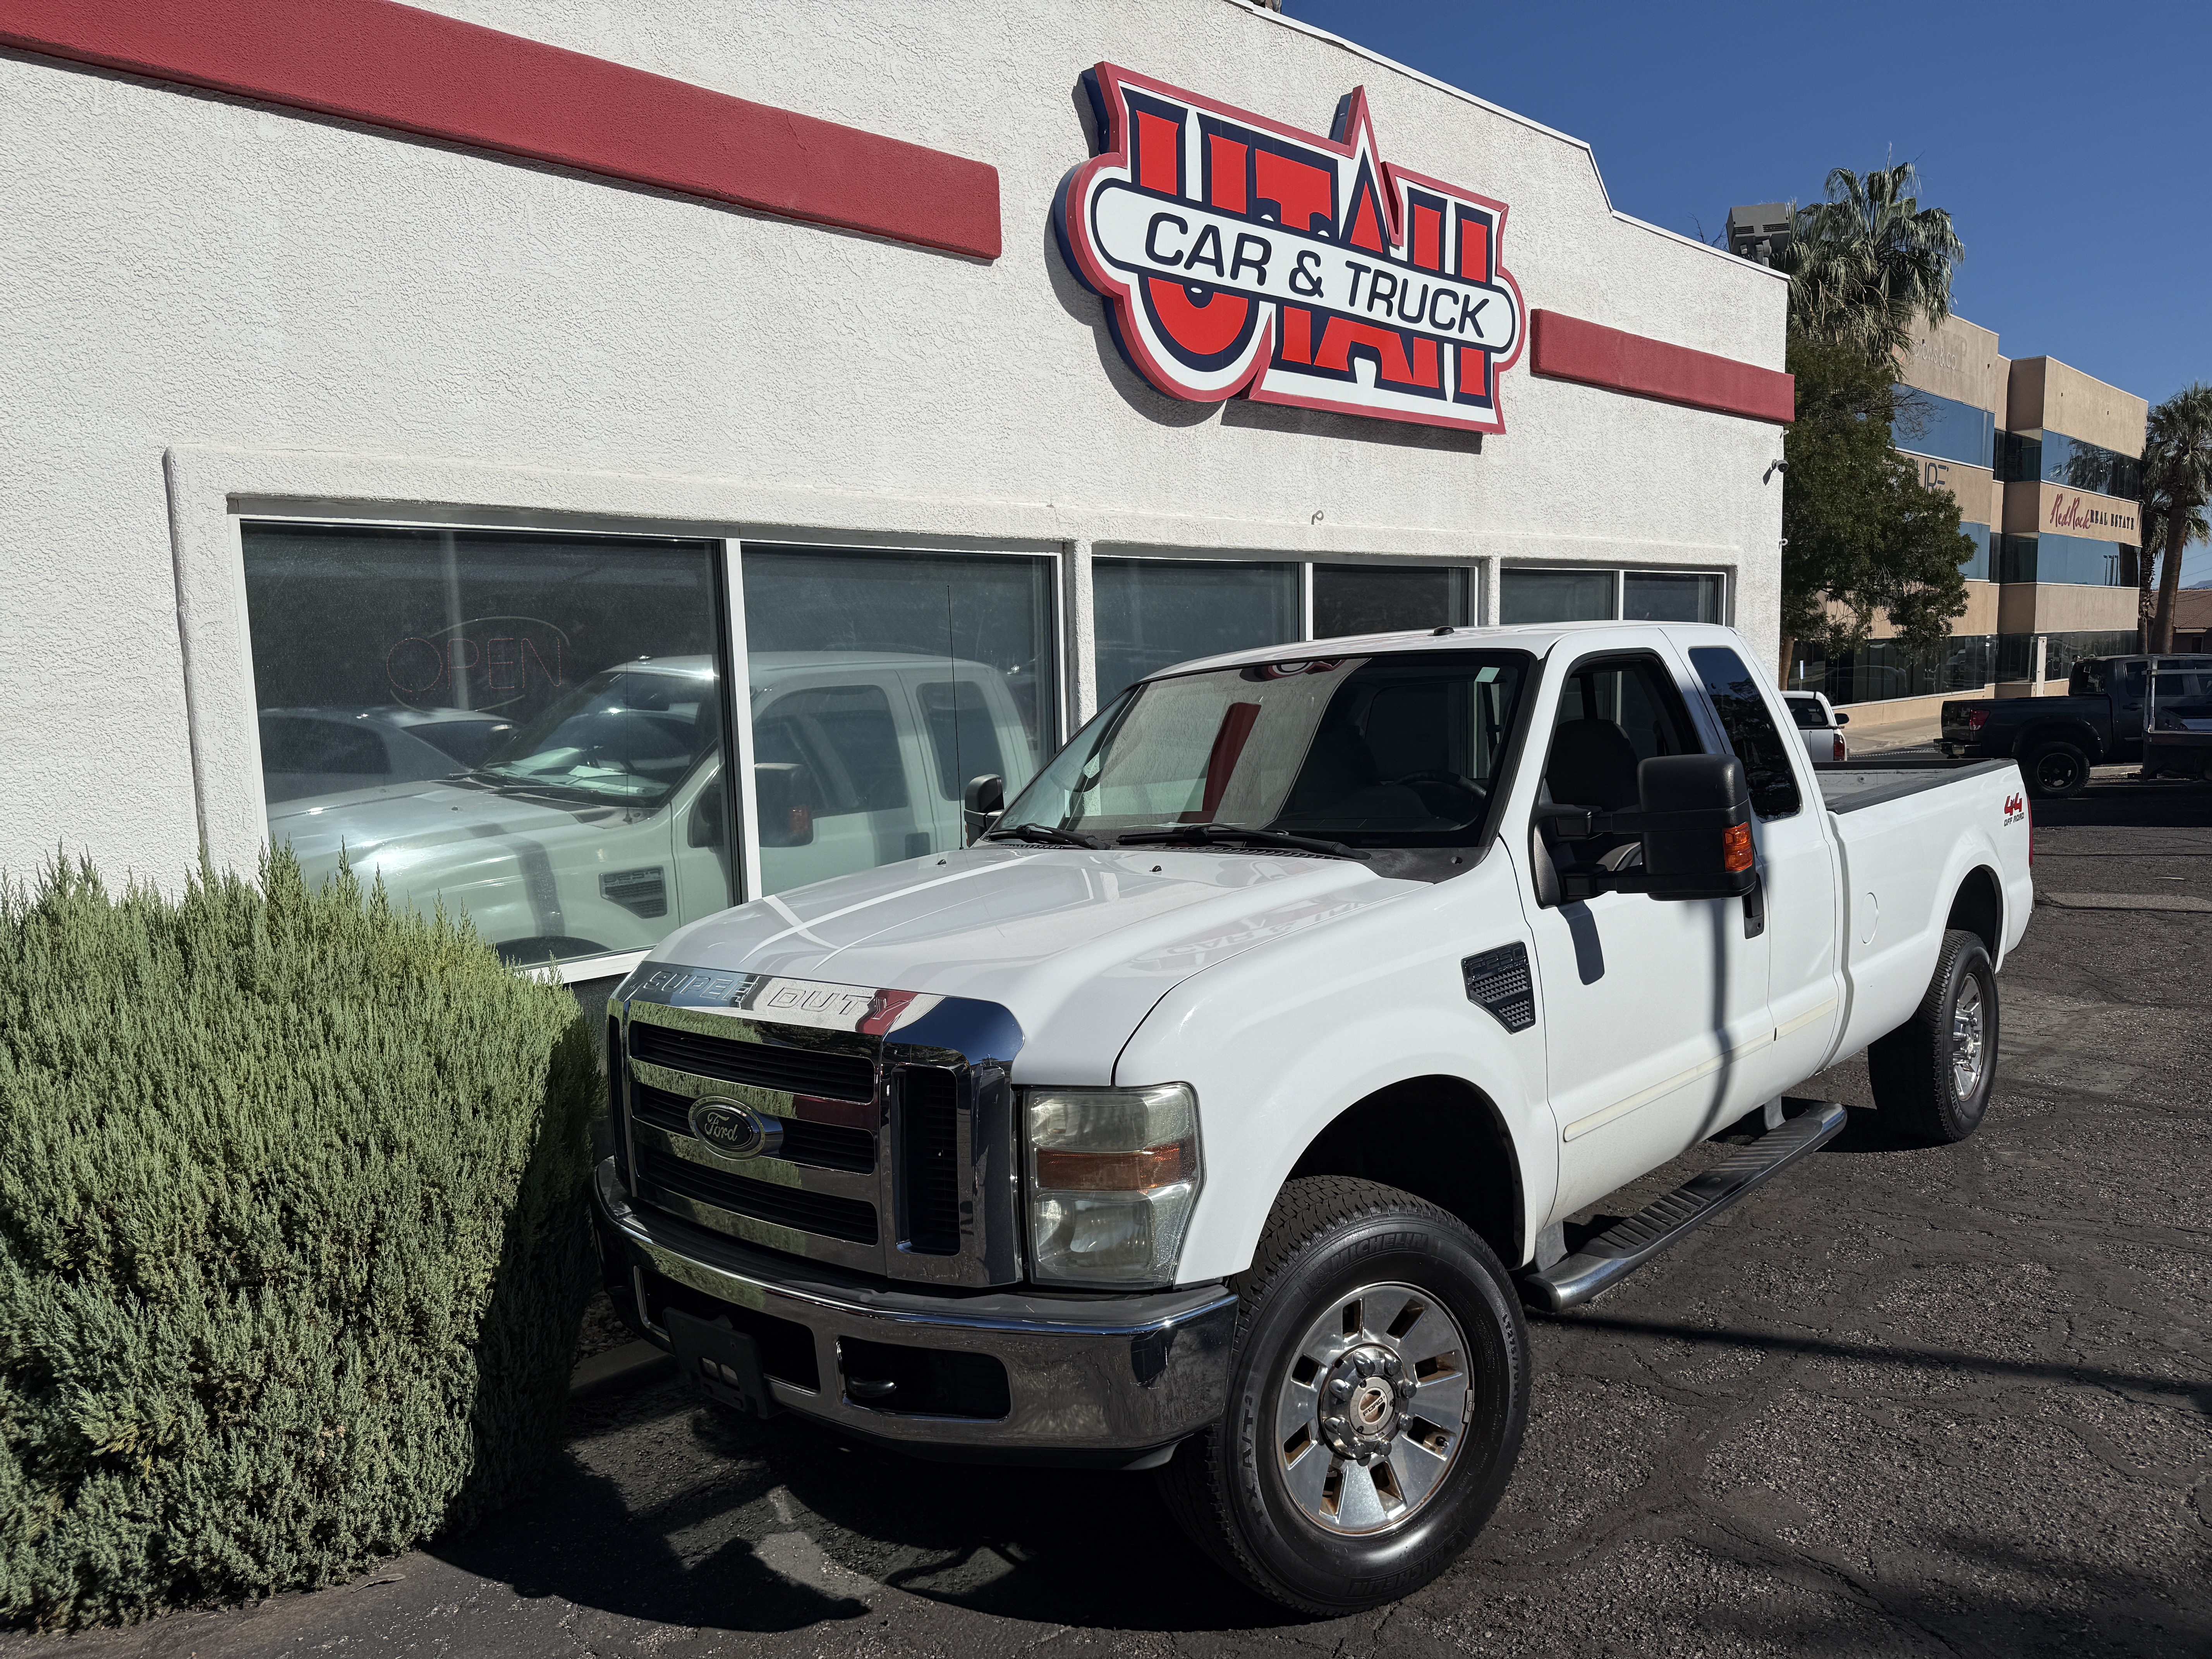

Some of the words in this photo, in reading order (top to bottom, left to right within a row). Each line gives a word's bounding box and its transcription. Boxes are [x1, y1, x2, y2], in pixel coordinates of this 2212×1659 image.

[1144, 212, 1272, 287] CAR
[1288, 250, 1324, 298] &
[1345, 261, 1489, 339] TRUCK
[1939, 346, 1945, 368] &
[2090, 509, 2108, 526] REAL
[2111, 514, 2134, 530] ESTATE
[386, 637, 562, 692] OPEN
[2004, 817, 2013, 827] OFF
[2013, 812, 2024, 823] ROAD
[1468, 946, 1525, 976] F-250
[643, 970, 758, 1004] SUPER
[767, 987, 913, 1020] DUTY
[704, 1112, 738, 1142] Ford
[1331, 1233, 1429, 1271] MICHELIN
[1363, 1397, 1383, 1416] FORD
